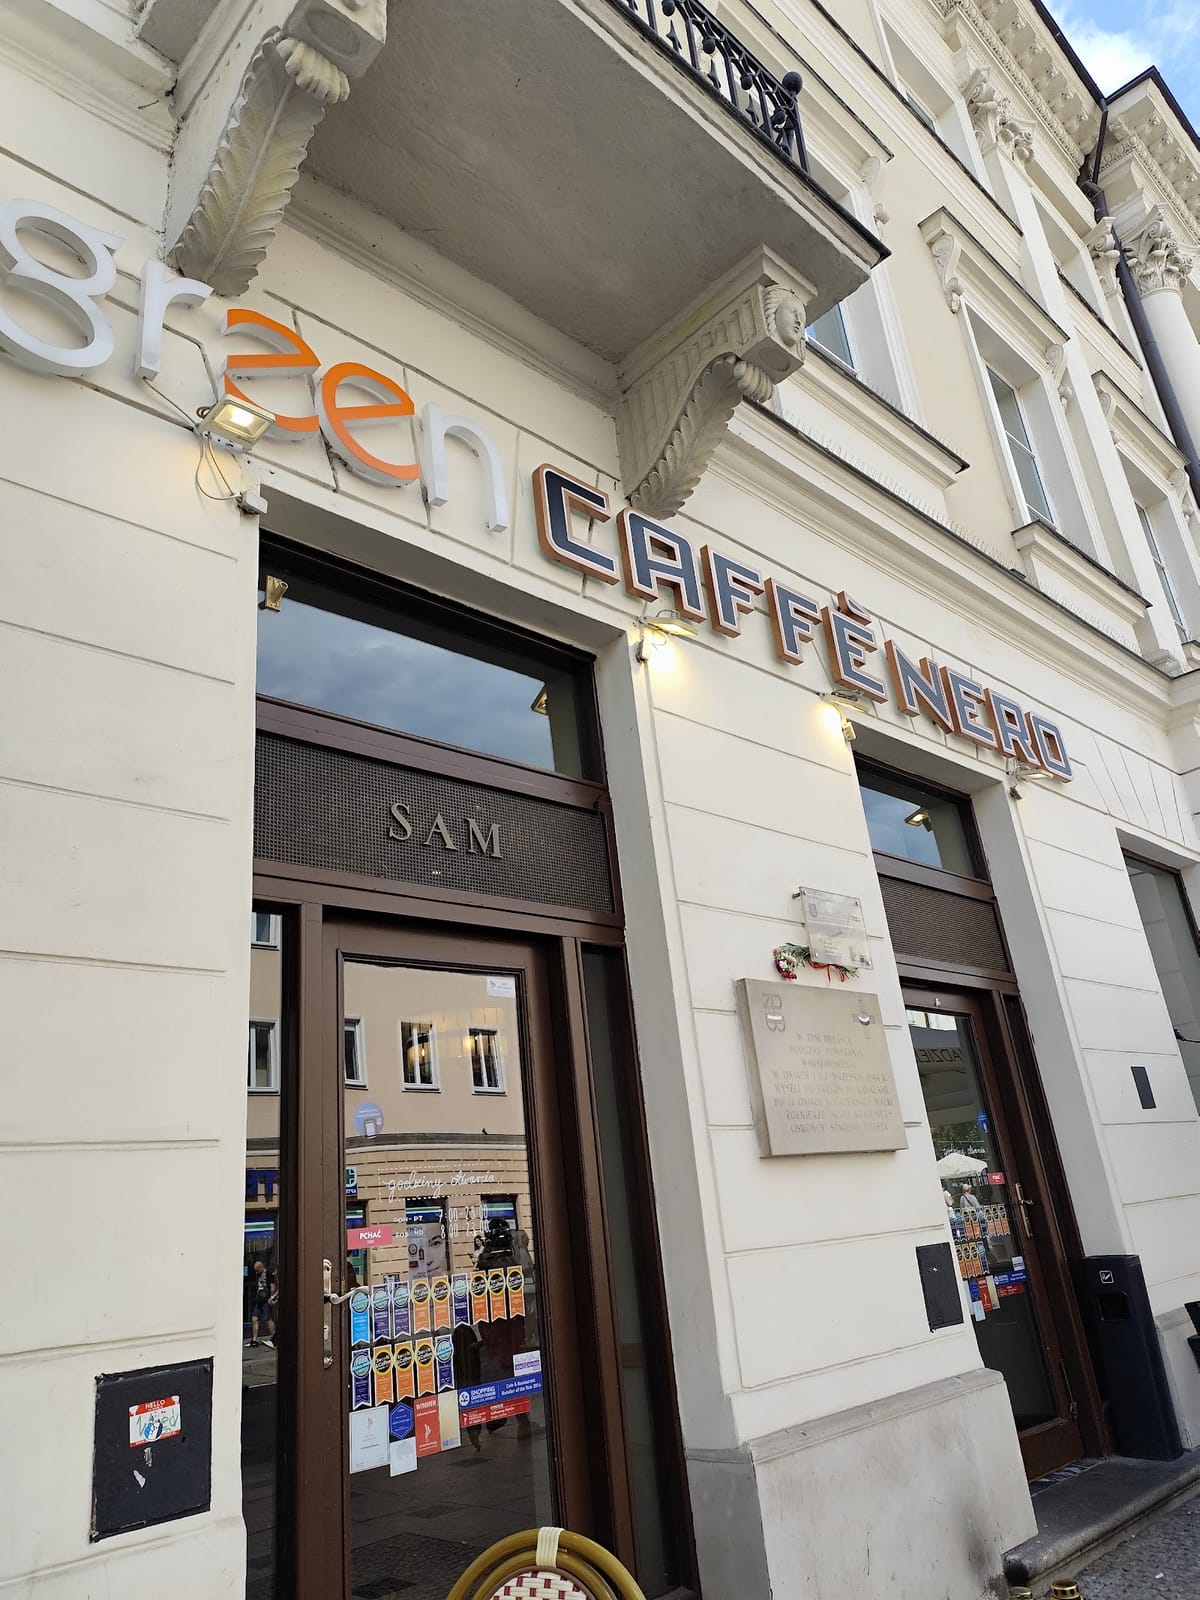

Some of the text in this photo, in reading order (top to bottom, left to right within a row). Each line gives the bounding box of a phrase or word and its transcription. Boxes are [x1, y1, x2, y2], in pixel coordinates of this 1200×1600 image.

[0, 198, 508, 532] green
[884, 639, 1073, 783] NERO
[389, 802, 503, 858] SAM
[382, 1169, 495, 1203] godziny otwarcia
[359, 1228, 382, 1240] PCHAĆ
[145, 1399, 166, 1409] HELLO
[415, 1400, 437, 1410] WINNER
